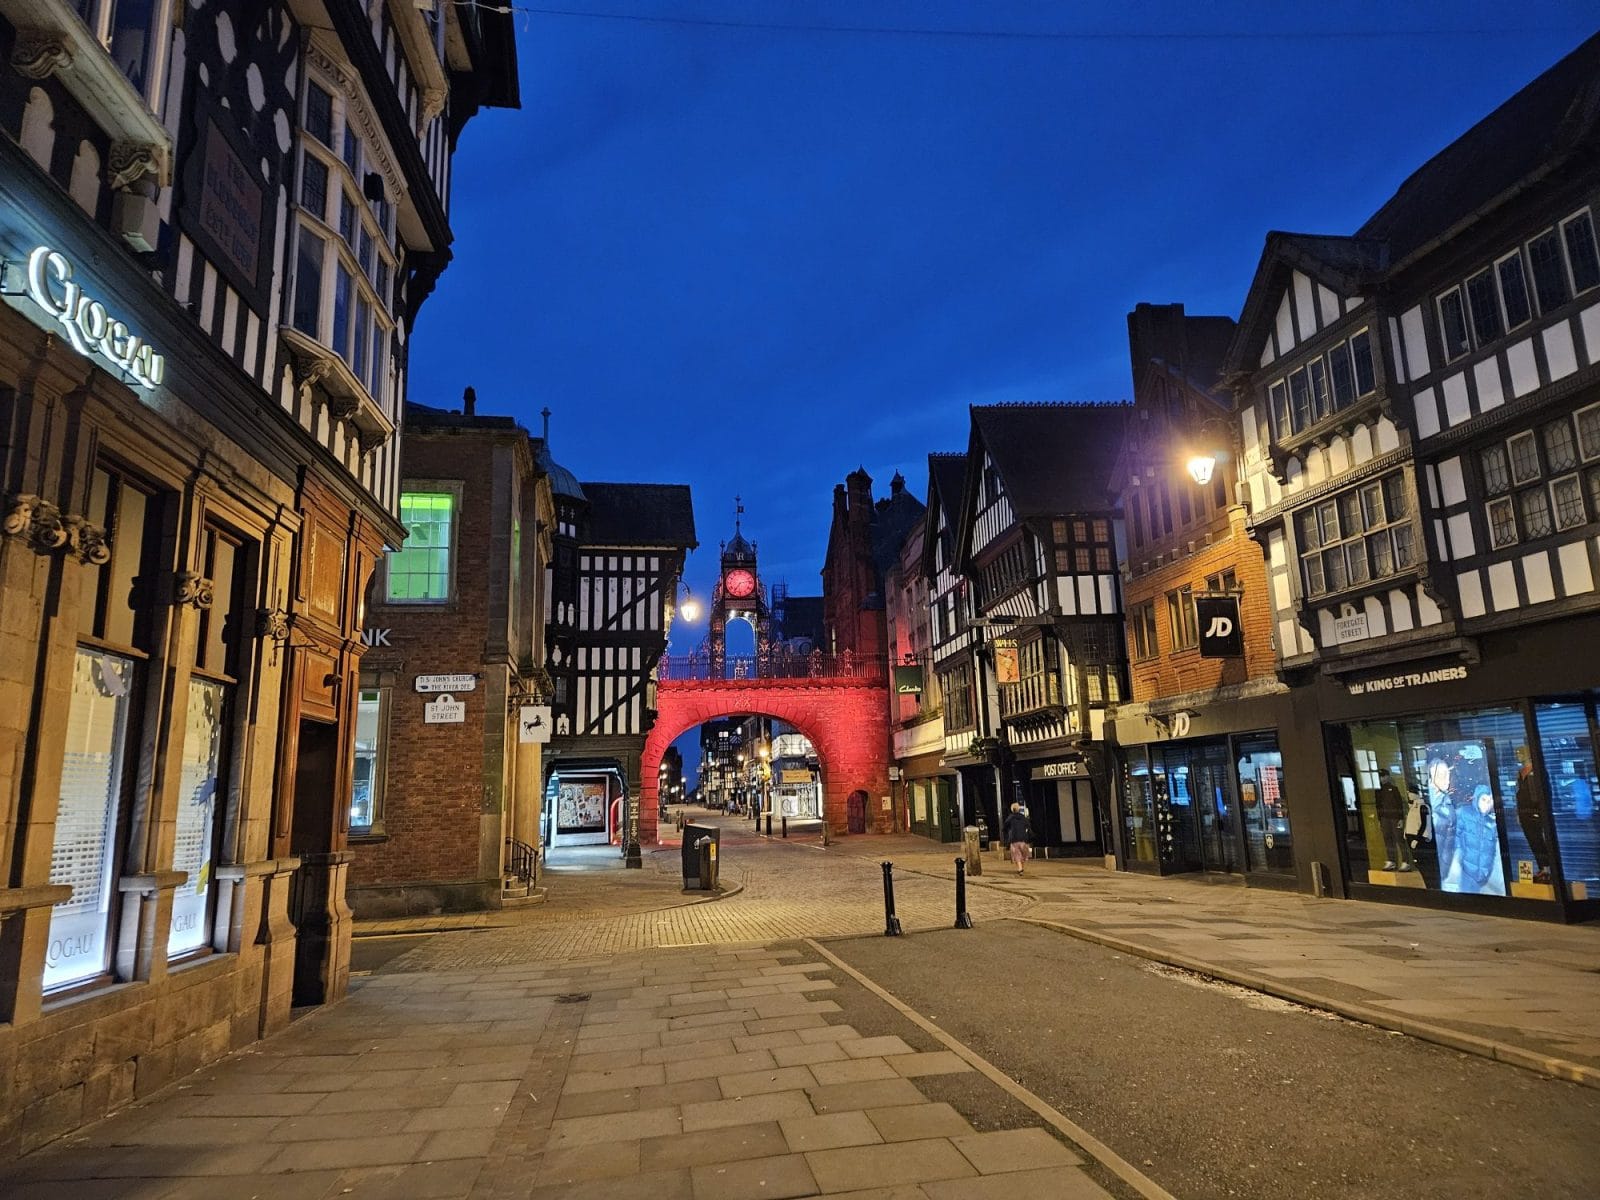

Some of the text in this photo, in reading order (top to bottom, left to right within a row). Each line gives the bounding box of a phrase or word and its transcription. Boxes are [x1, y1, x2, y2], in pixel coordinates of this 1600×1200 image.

[1205, 616, 1233, 638] JD
[1336, 616, 1365, 630] FOREGATE
[1340, 628, 1362, 639] STREET
[1366, 666, 1468, 693] KING OF TRAINERS
[1172, 712, 1191, 738] JD
[1043, 761, 1077, 777] POST OFFICE
